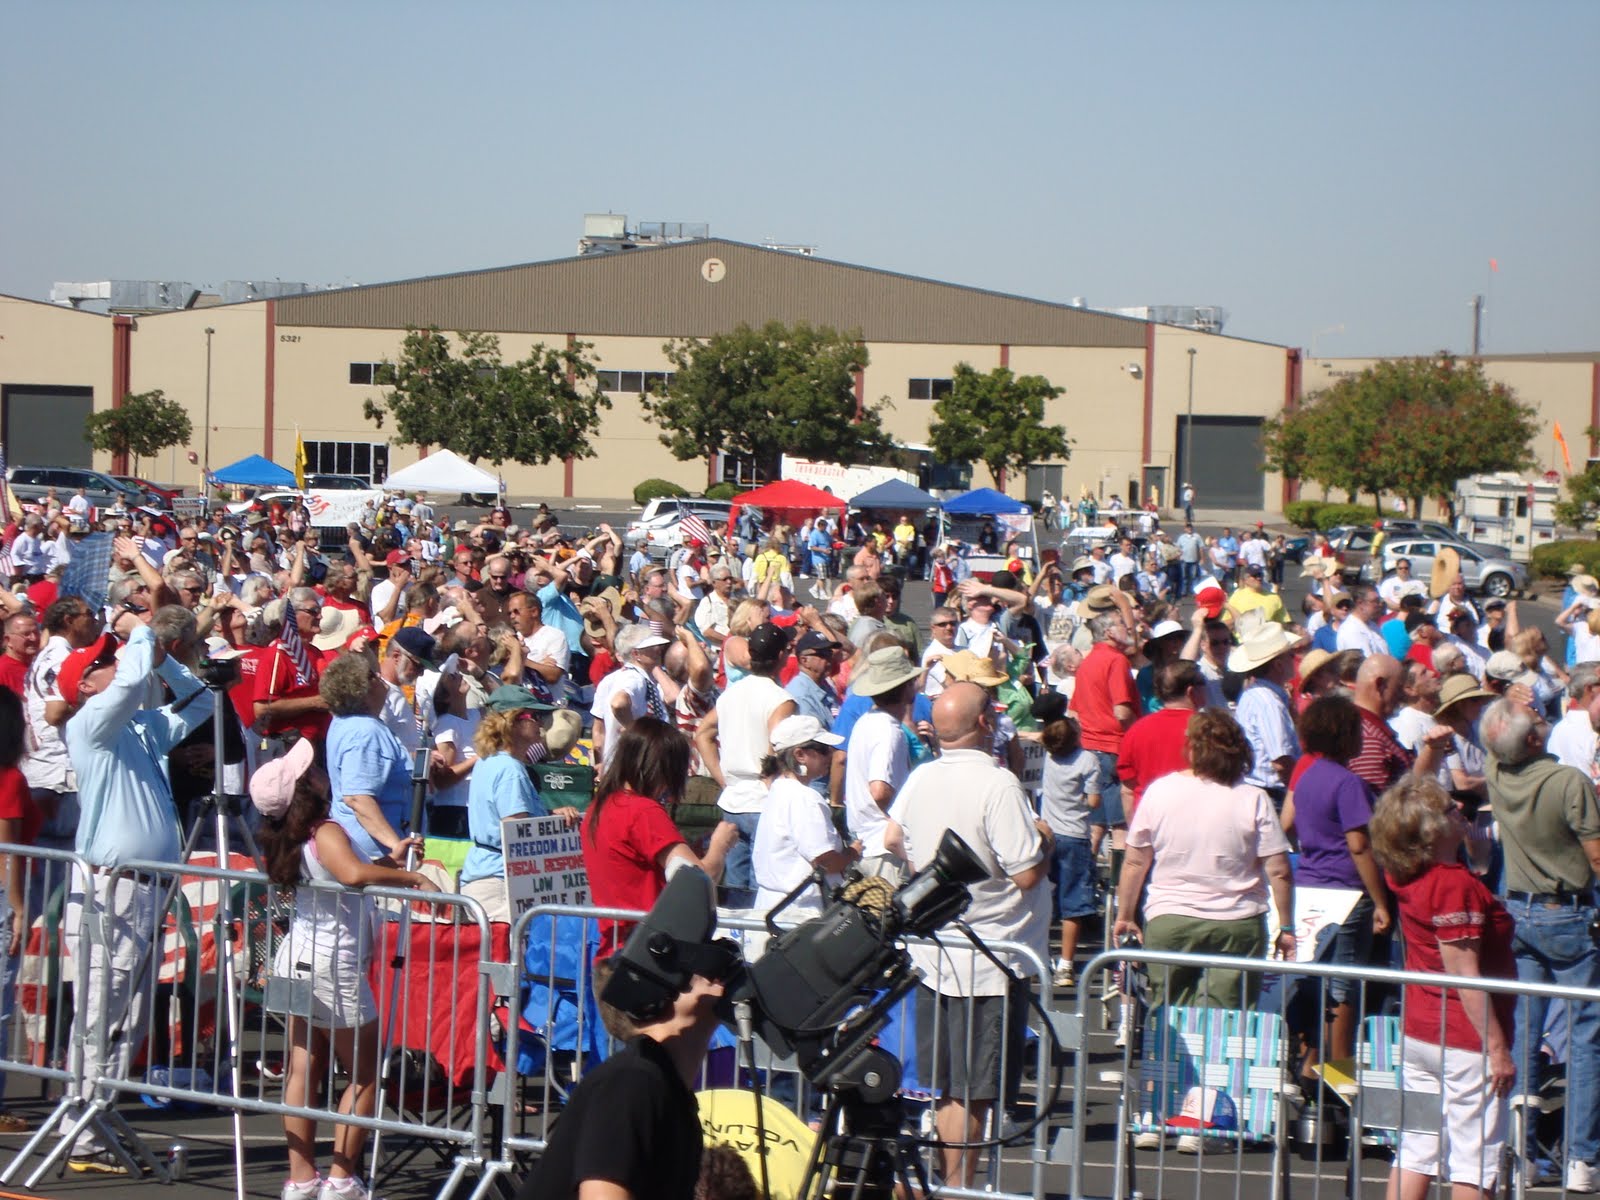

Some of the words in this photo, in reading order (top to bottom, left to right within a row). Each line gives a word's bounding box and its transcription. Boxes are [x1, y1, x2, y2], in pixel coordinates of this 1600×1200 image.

[708, 262, 720, 279] F
[515, 822, 533, 839] WE
[508, 839, 559, 858] FREEDOM
[506, 860, 541, 877] FISCAL
[532, 876, 553, 893] LOW
[562, 872, 590, 889] TAXE
[516, 898, 535, 914] THE
[575, 890, 587, 905] OF
